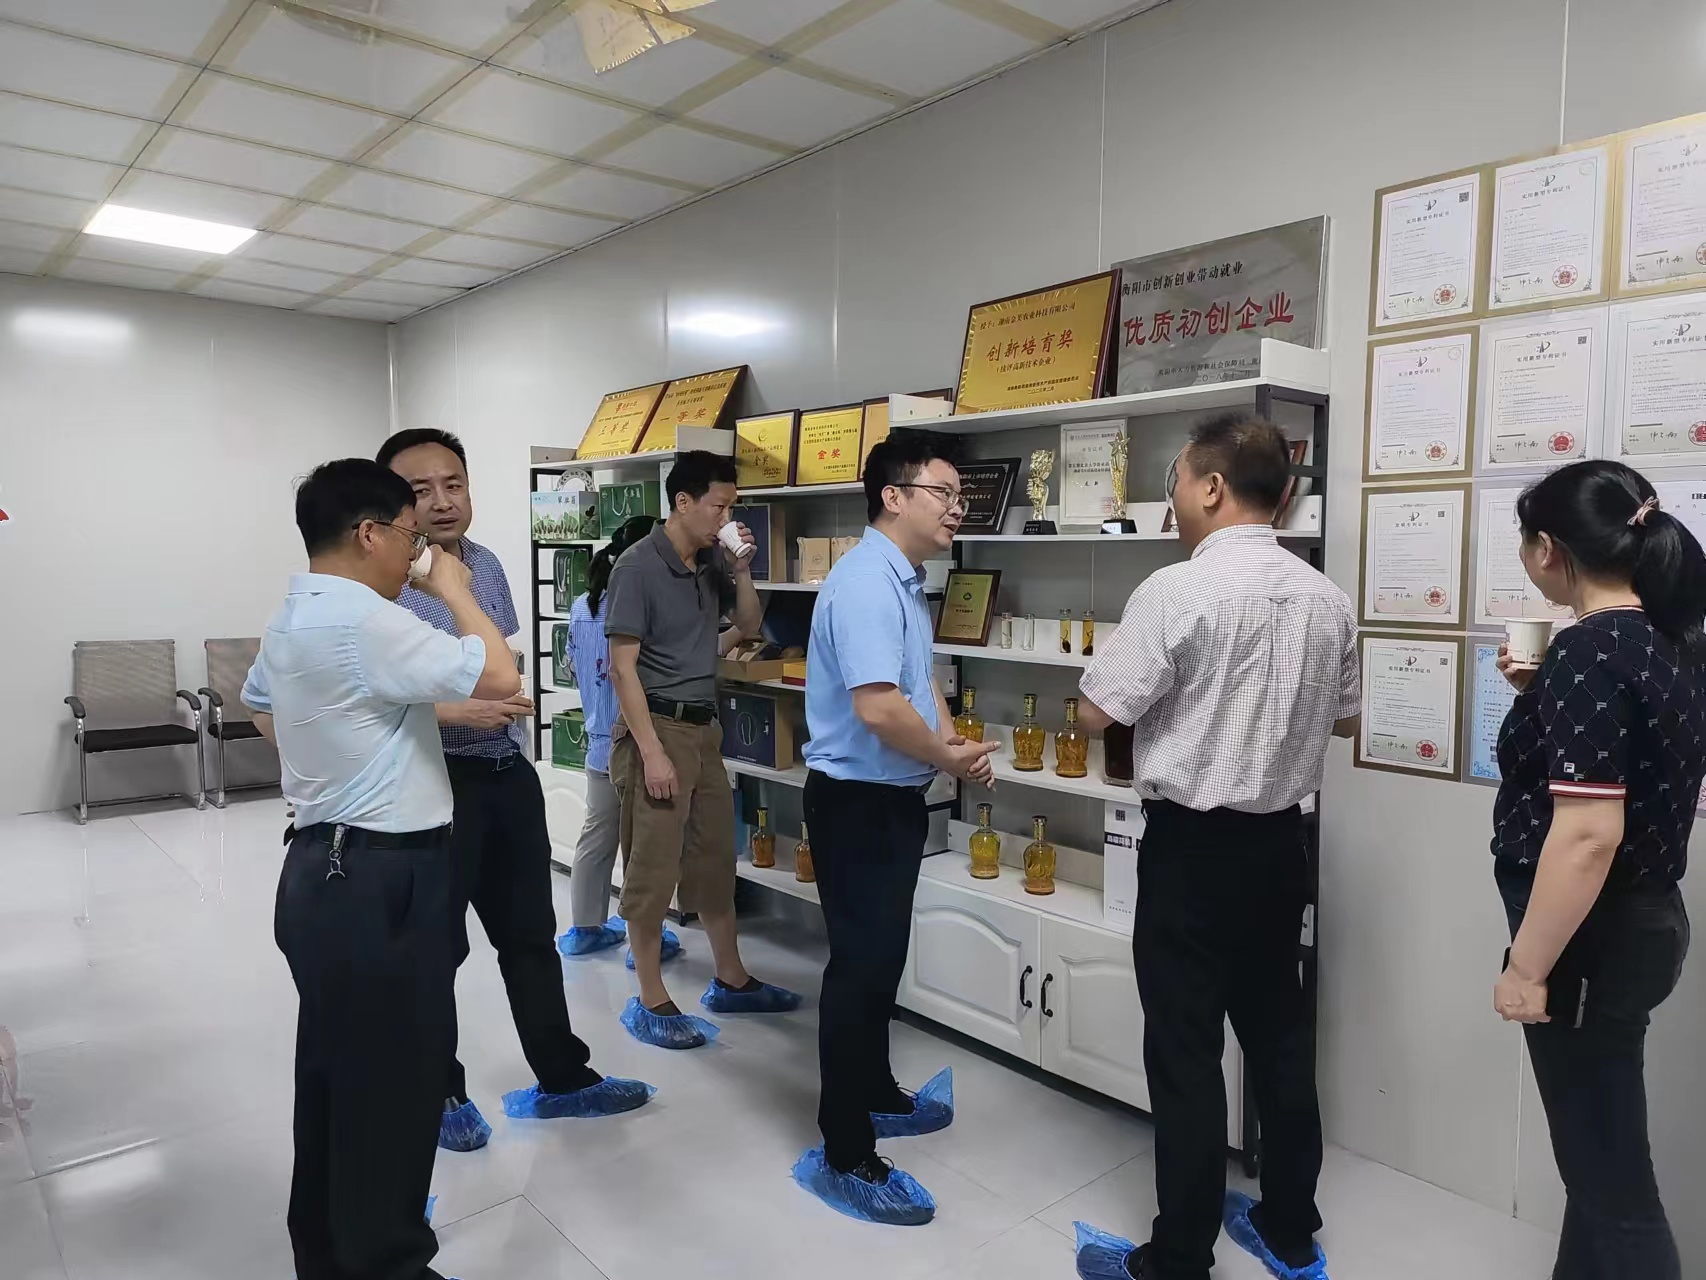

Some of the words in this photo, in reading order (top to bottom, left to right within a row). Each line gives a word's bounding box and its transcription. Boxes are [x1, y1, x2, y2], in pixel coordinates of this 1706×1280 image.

[1124, 291, 1294, 347] 优质初创企业
[986, 329, 1073, 361] 创新培育奖
[817, 448, 841, 460] 金奖
